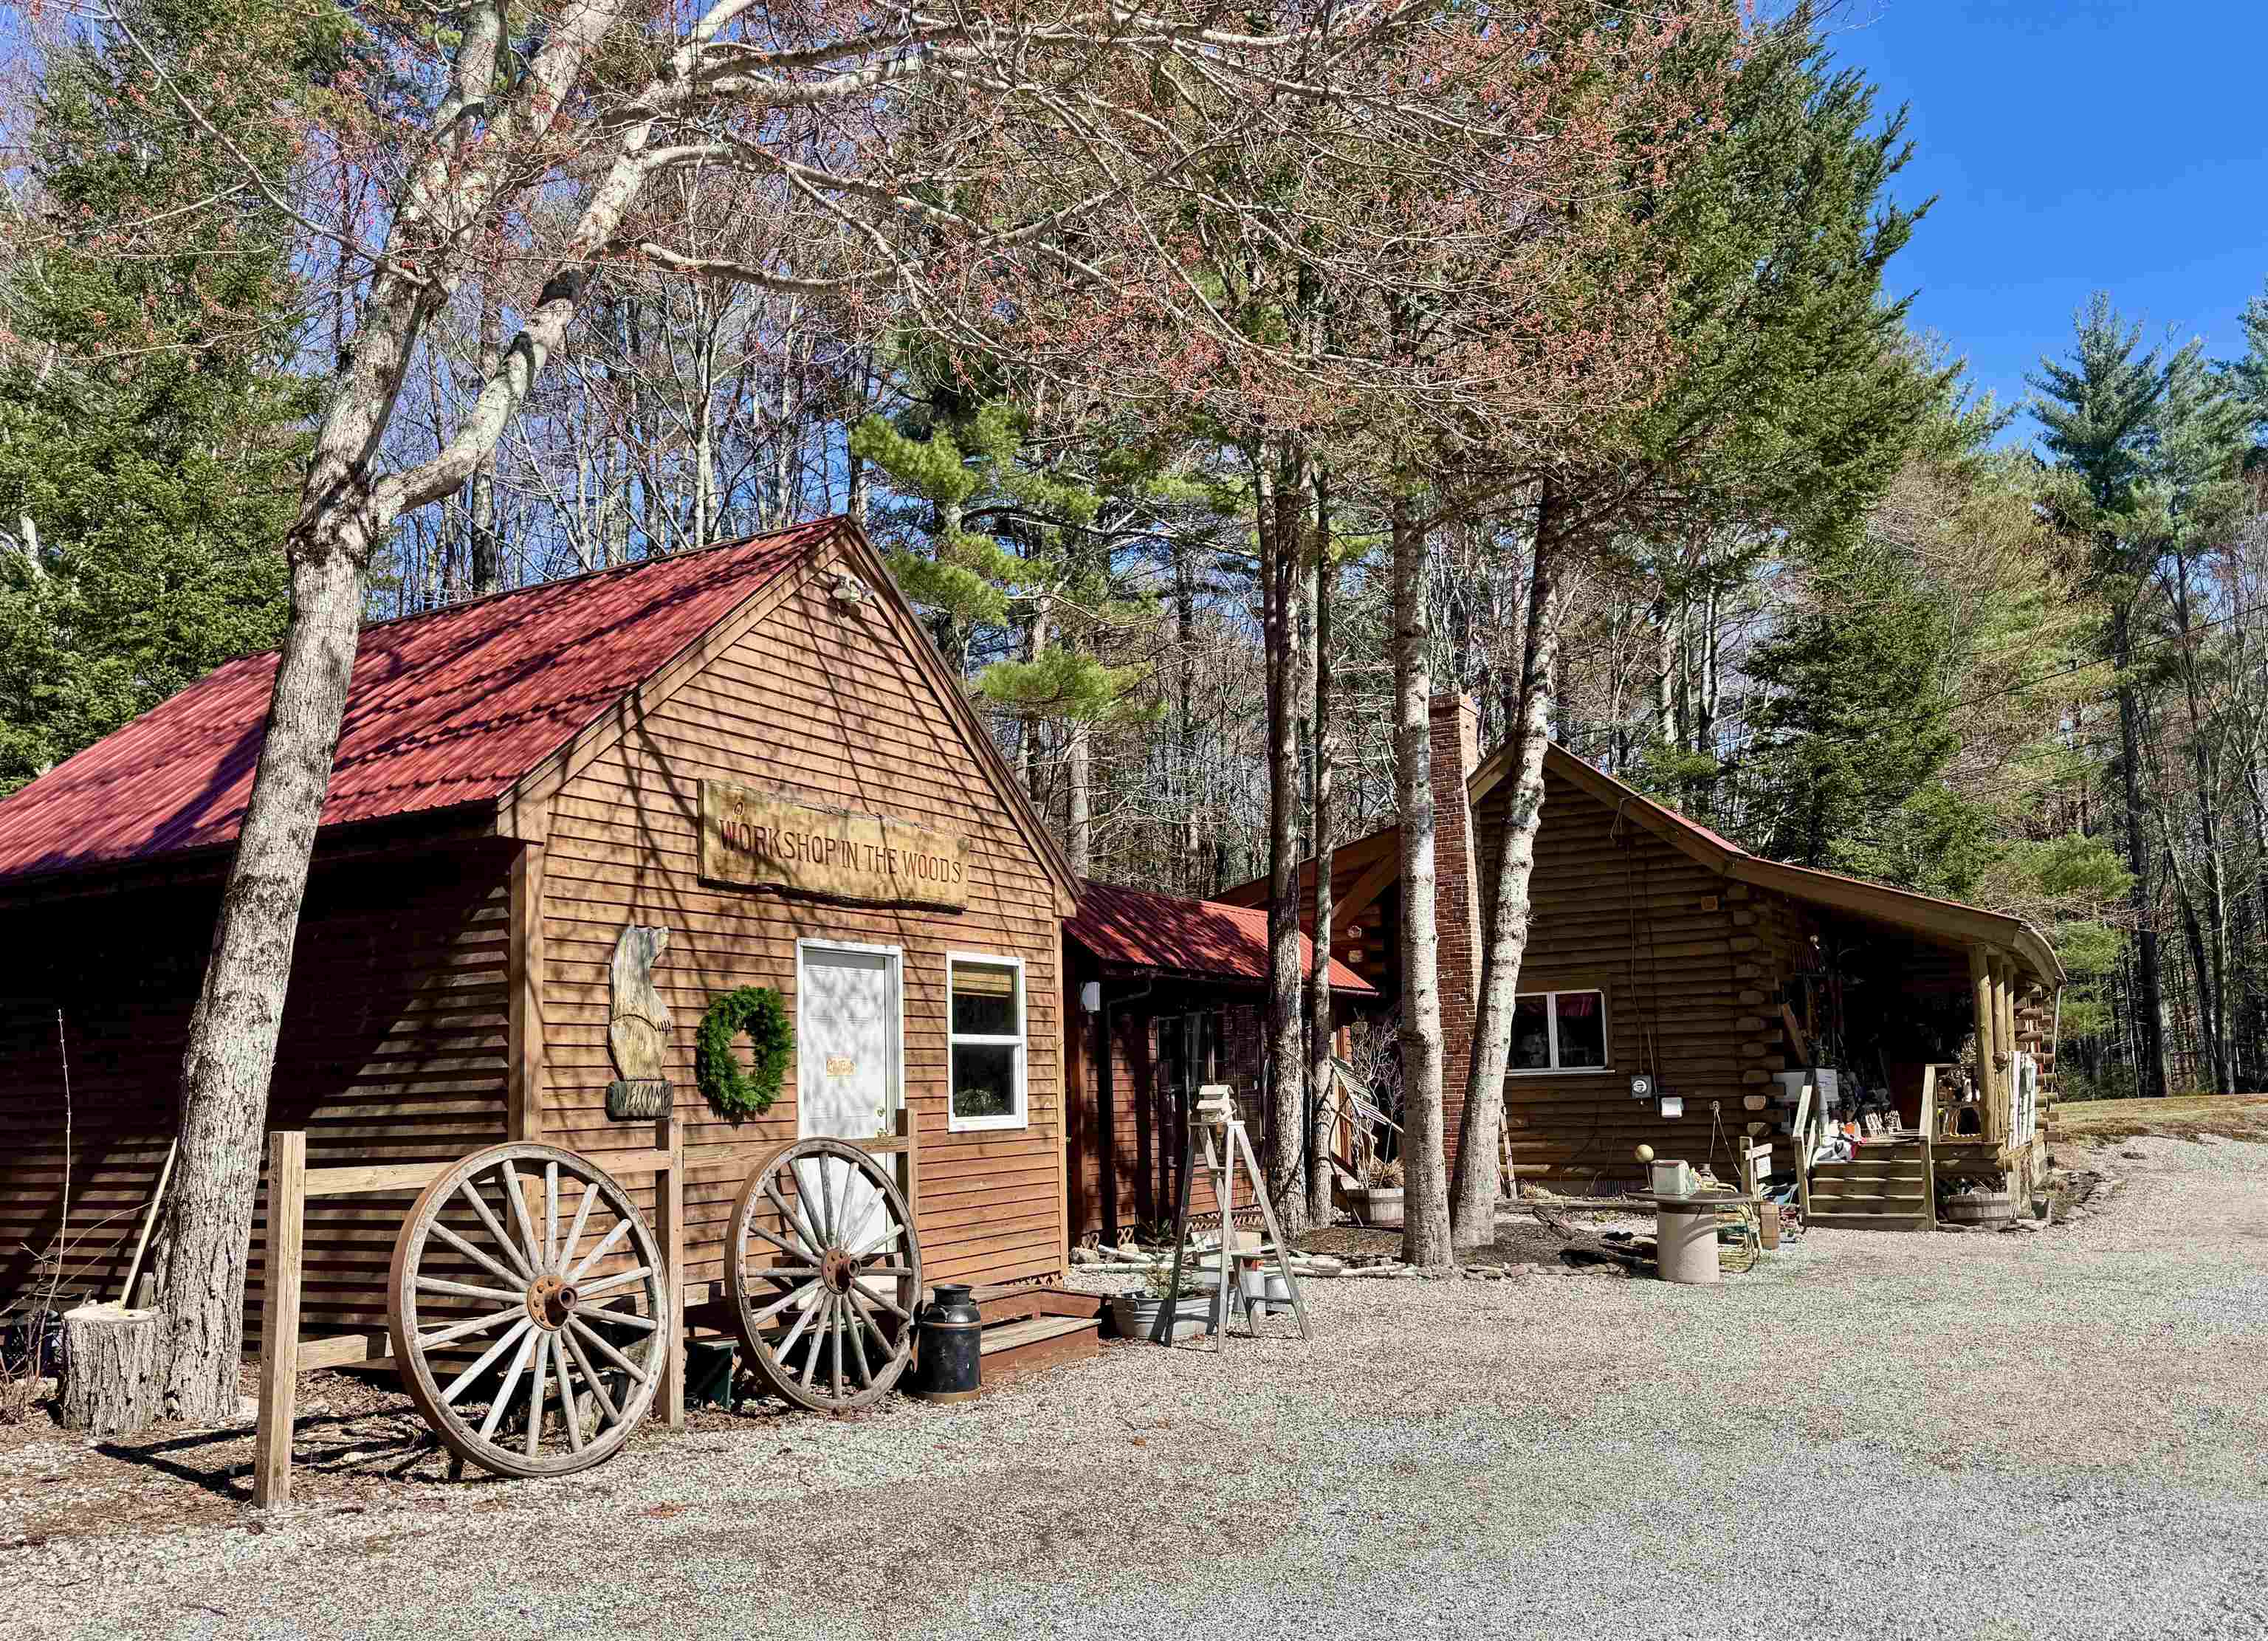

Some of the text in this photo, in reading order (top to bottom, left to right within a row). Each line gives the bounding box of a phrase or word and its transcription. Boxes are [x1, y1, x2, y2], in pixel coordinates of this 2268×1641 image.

[719, 819, 961, 884] WORKSHOP IN THE WOODS
